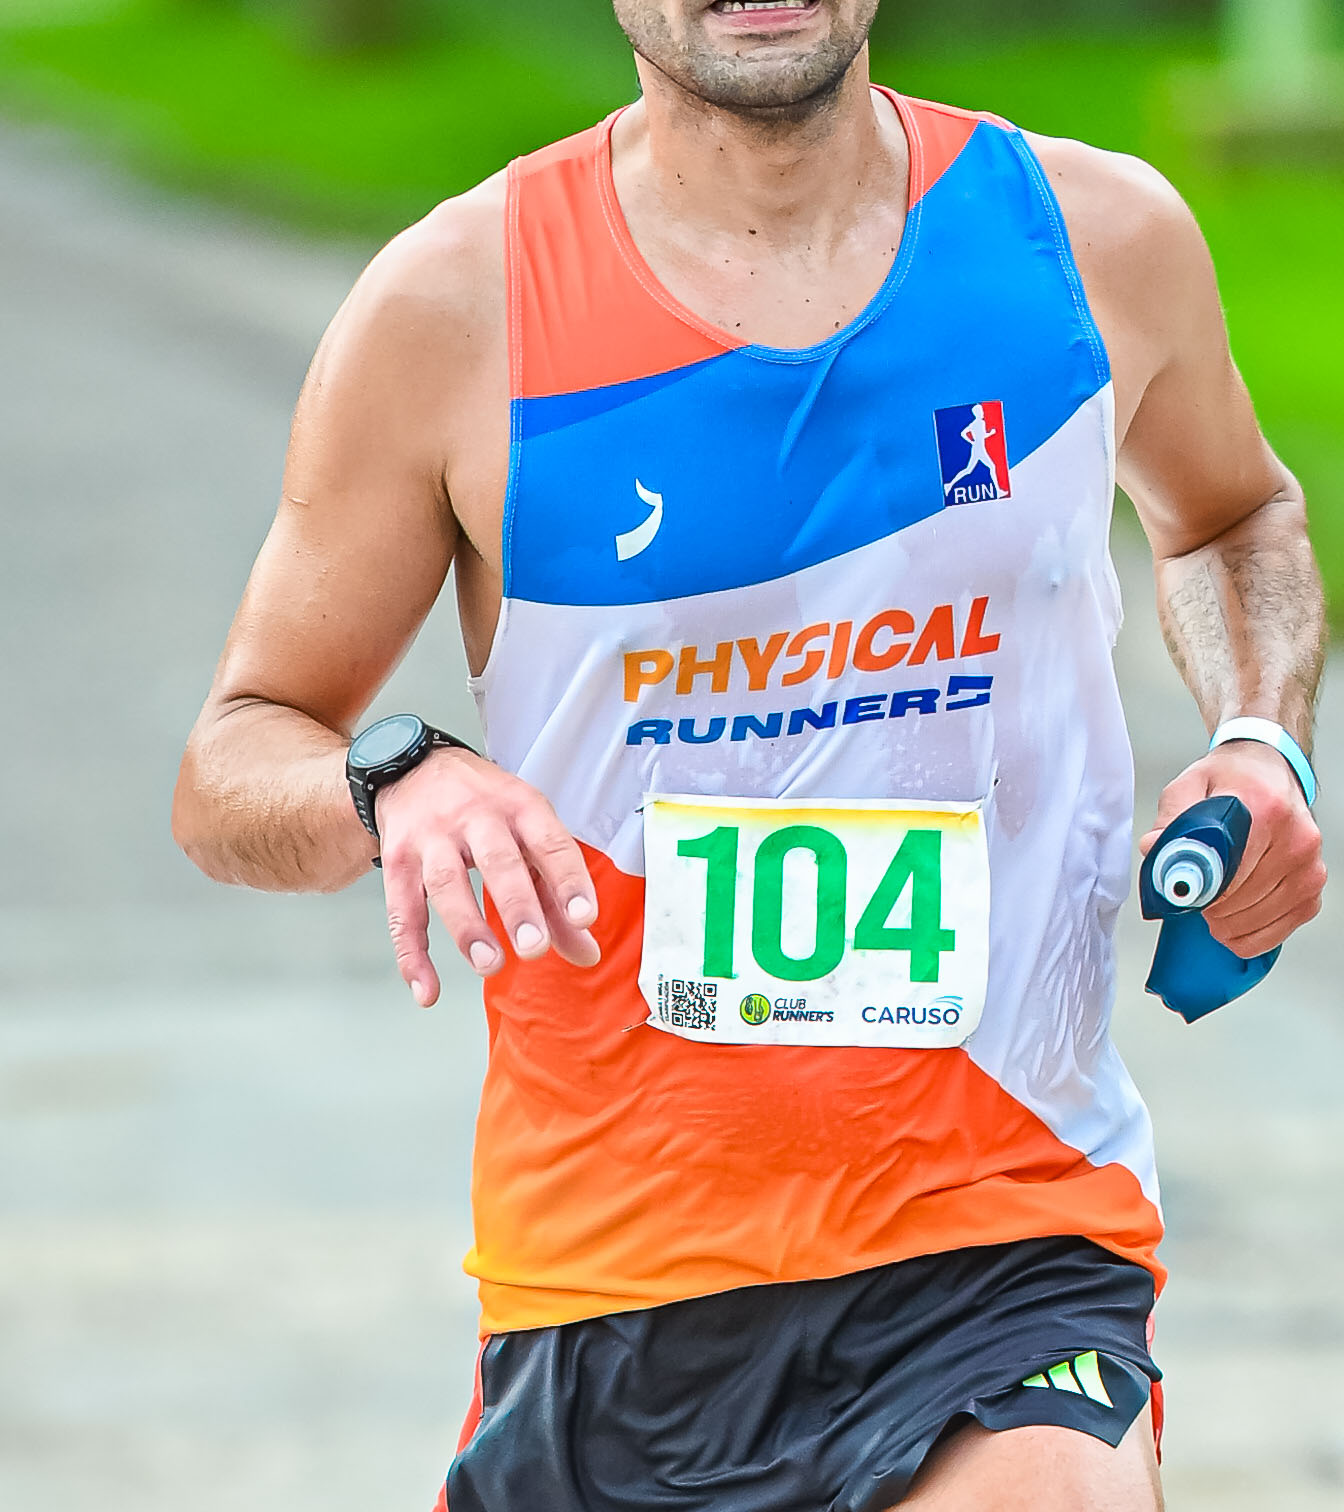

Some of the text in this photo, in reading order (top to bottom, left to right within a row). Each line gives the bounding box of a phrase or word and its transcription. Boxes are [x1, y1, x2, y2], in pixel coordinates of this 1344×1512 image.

[954, 483, 995, 504] RUN
[624, 596, 1001, 702] PHYSICAL
[625, 675, 994, 746] RUNNERS
[676, 825, 956, 984] 104
[774, 997, 807, 1010] CLUB
[772, 1009, 835, 1023] RUNNER'S
[861, 1005, 960, 1026] CARUSO
